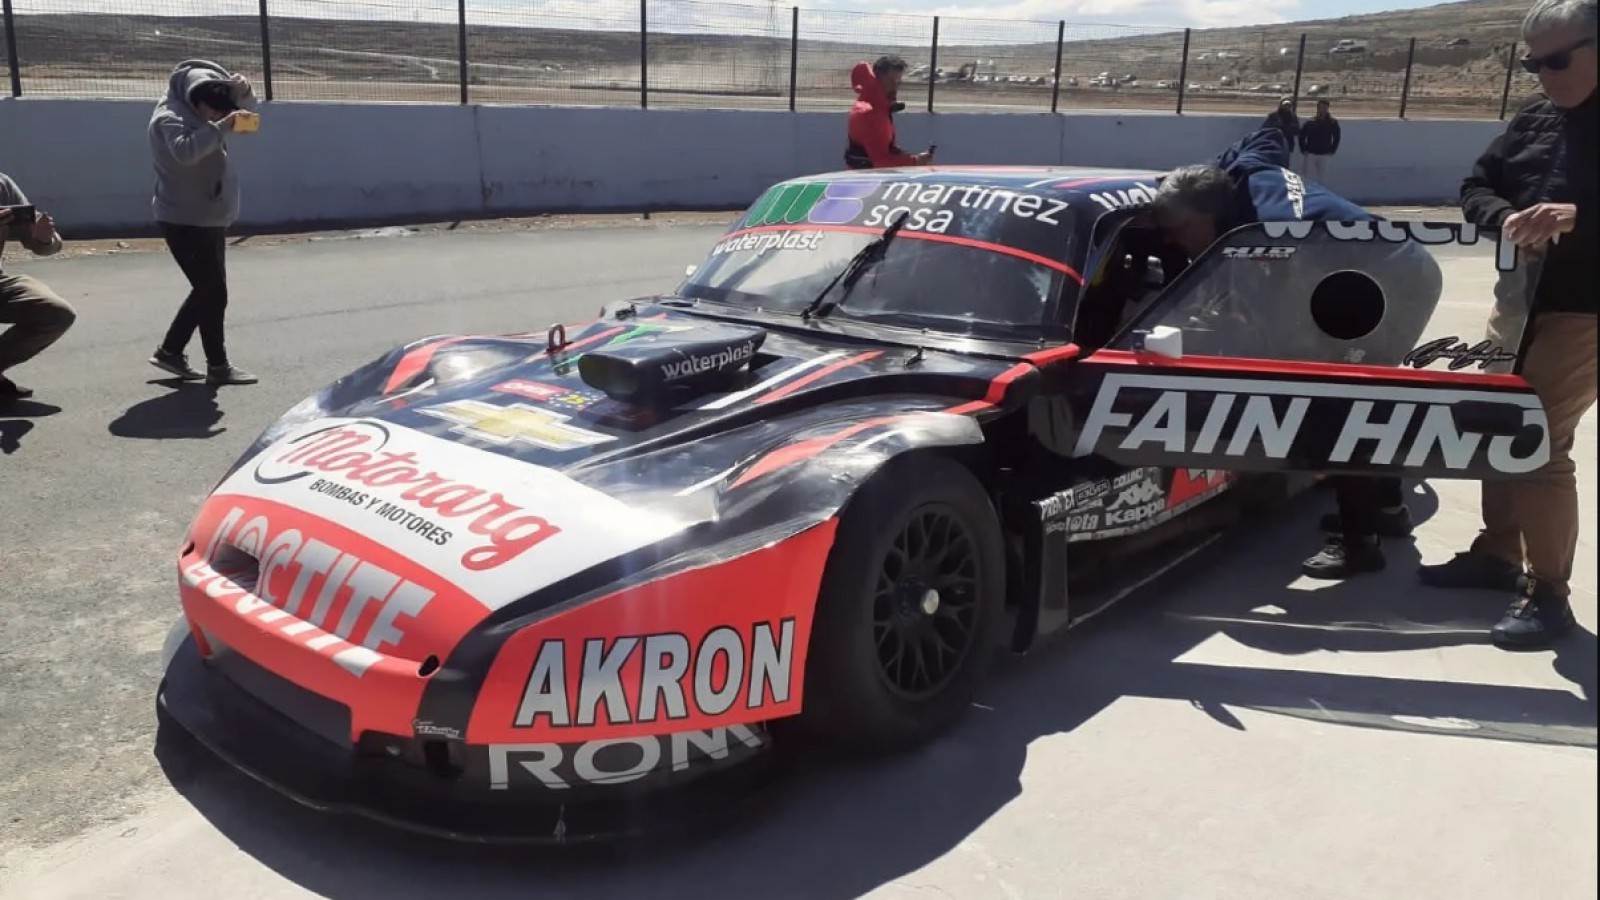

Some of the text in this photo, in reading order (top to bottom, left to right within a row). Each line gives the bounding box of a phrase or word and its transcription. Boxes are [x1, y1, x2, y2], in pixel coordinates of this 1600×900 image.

[863, 204, 954, 234] sosa
[881, 181, 1070, 226] martinez
[711, 229, 826, 256] waterplast
[660, 340, 756, 380] waterplast
[1072, 372, 1310, 459] FAIN
[276, 427, 563, 572] Motorarg
[308, 478, 454, 547] BOMBAS Y MOTORES
[1105, 499, 1165, 526] Kappa
[183, 506, 437, 678] LOCTITE
[512, 617, 796, 728] AKRON
